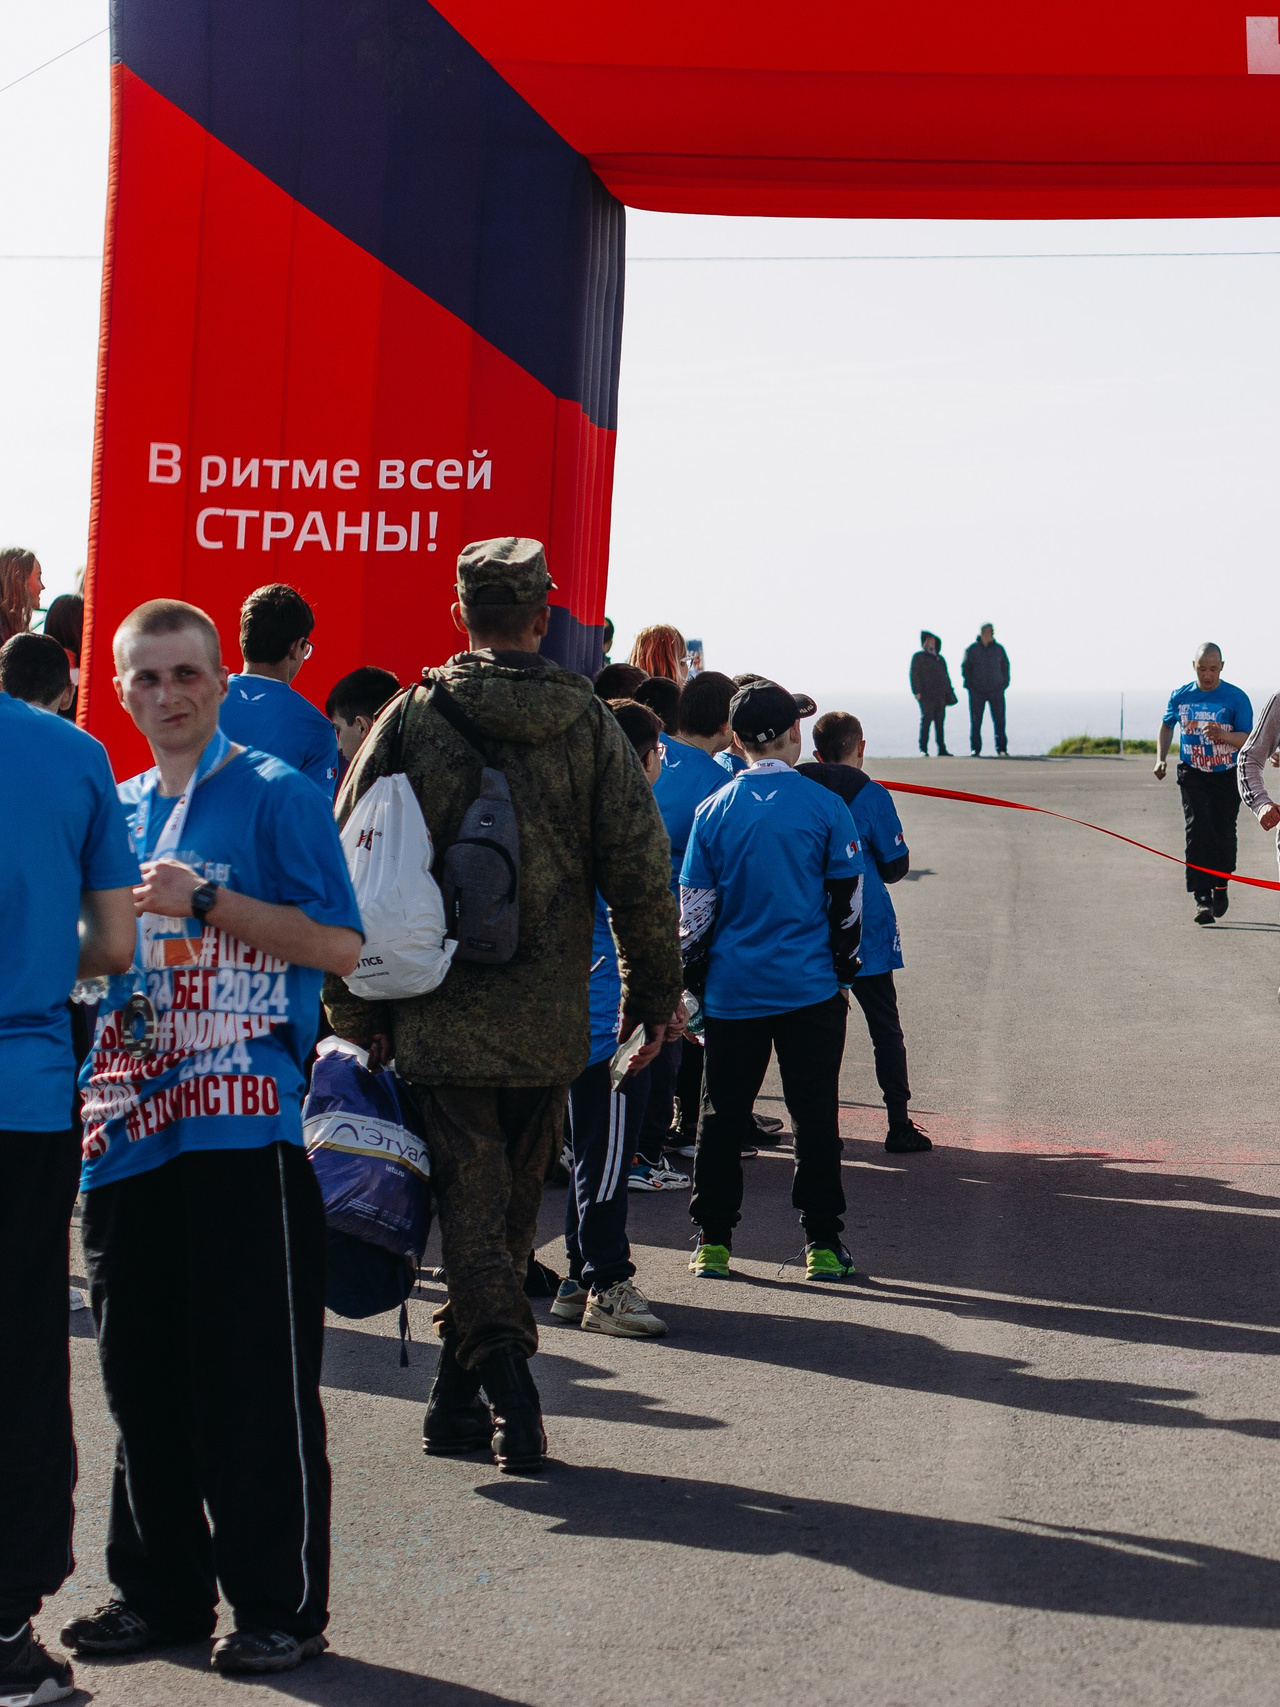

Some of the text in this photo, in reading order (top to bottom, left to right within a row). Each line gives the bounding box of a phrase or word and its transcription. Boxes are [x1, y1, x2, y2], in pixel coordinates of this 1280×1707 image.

[148, 442, 492, 493] В ритме всей
[196, 507, 439, 552] СТРАНЫ!
[361, 956, 384, 967] ПСБ
